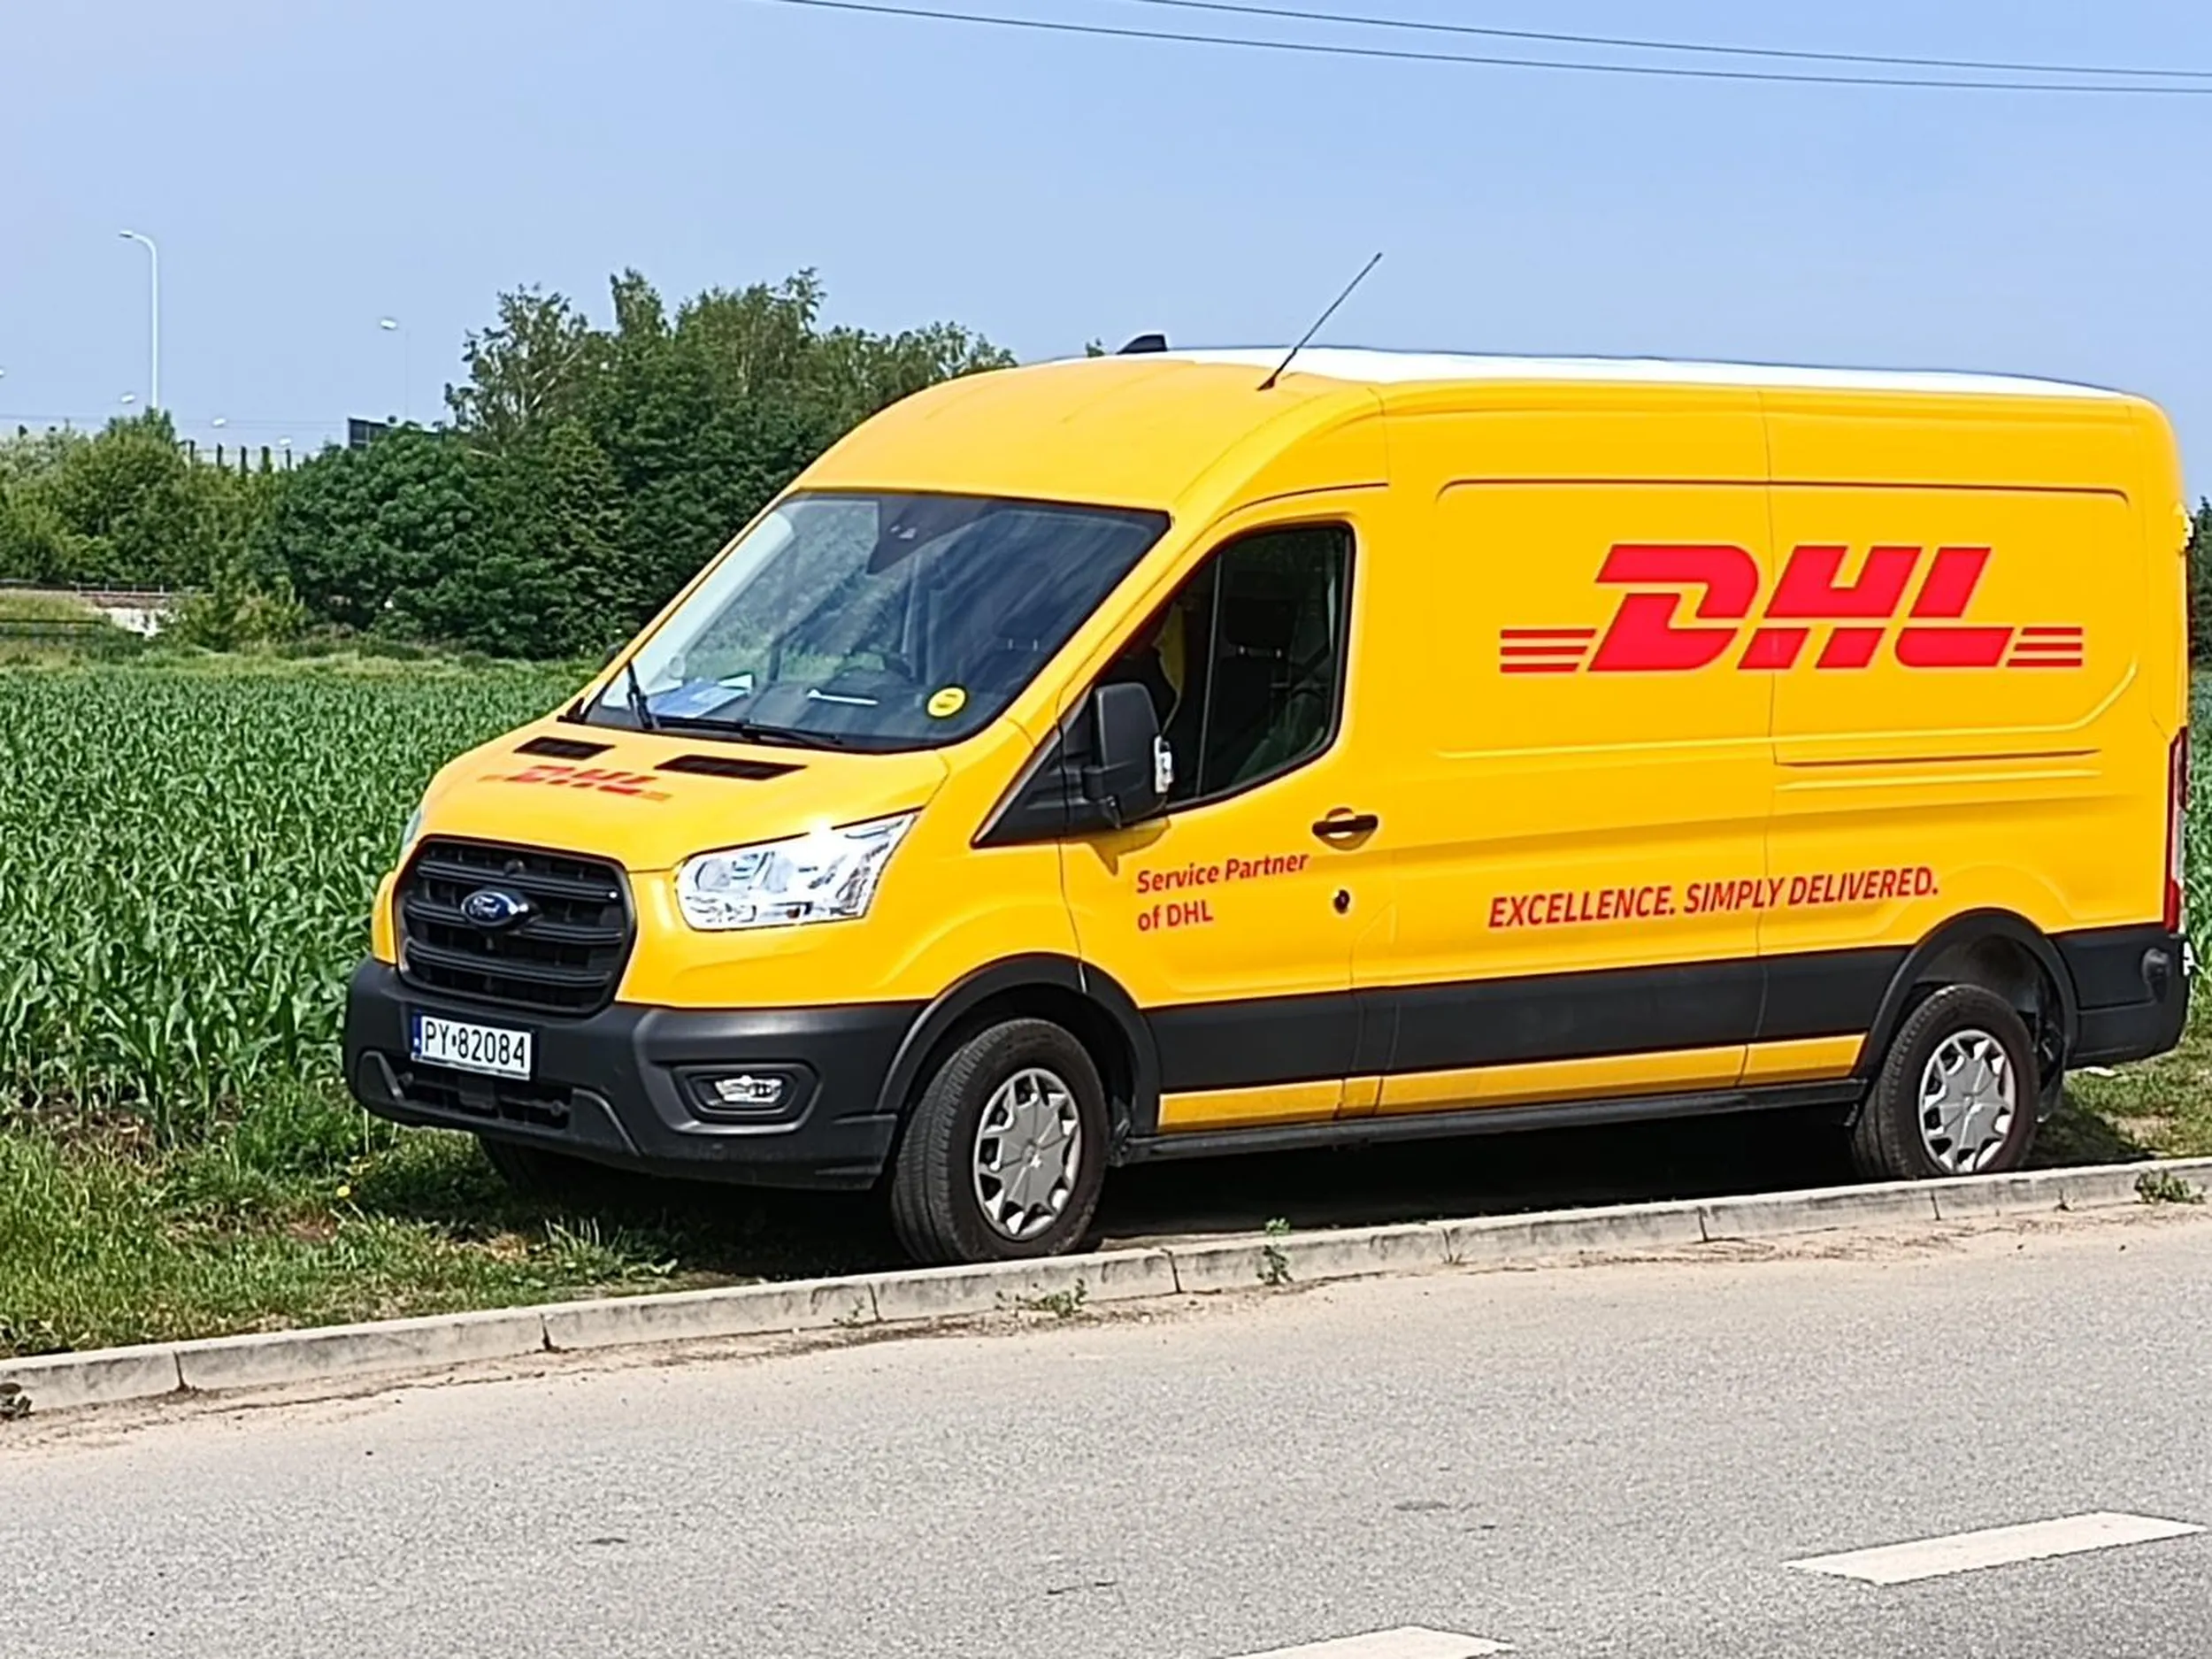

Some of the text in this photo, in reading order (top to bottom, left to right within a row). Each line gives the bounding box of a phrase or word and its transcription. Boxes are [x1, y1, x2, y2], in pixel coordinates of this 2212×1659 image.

[1587, 543, 2016, 672] DHL
[503, 764, 659, 795] DHL
[1136, 853, 1310, 895] Service Partner
[1137, 899, 1214, 932] of DHL
[1488, 866, 1940, 928] EXCELLENCE. SIMPLY DELIVERED.
[457, 1027, 526, 1068] 82084
